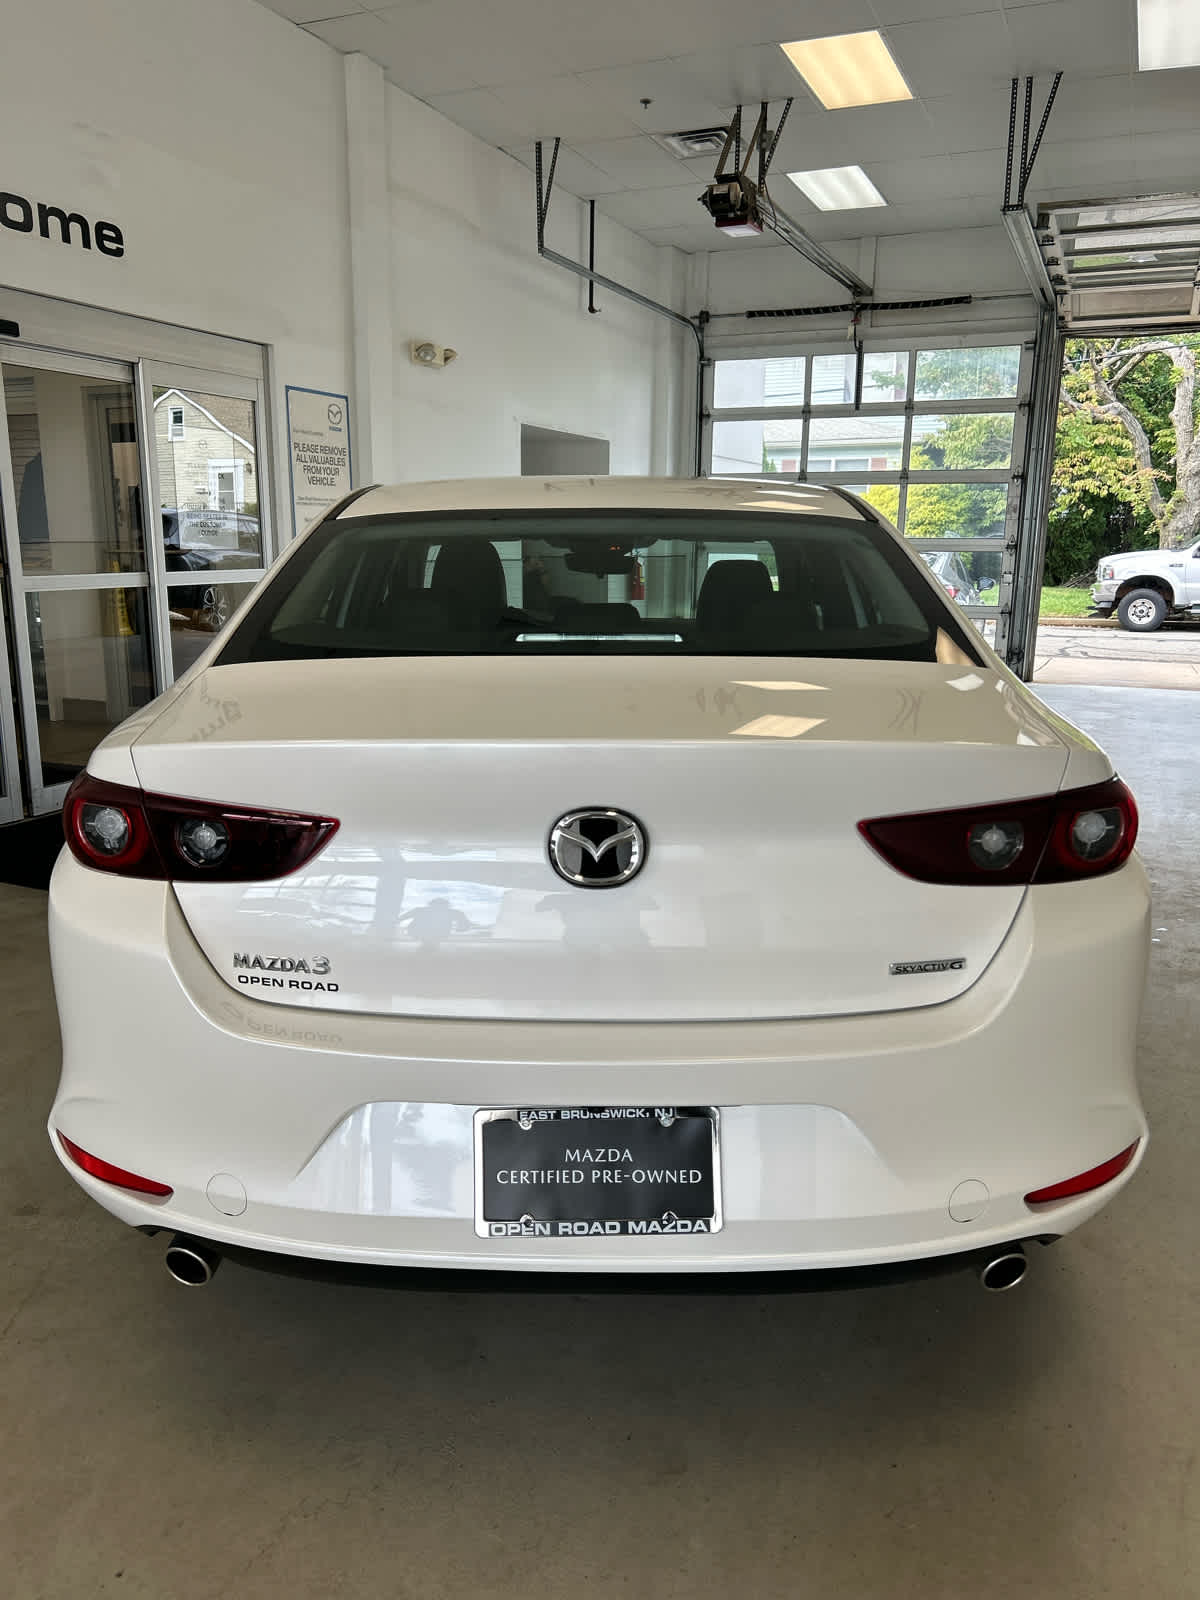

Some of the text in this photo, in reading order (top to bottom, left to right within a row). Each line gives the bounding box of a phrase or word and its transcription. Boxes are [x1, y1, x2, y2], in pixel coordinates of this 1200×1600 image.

[293, 442, 347, 457] PLEASE REMOVE
[296, 453, 346, 467] ALL VALUABLES
[303, 465, 340, 477] FROM YOUR
[238, 975, 339, 992] OPEN ROAD
[519, 1110, 556, 1120] EAST
[654, 1107, 674, 1119] NJ
[565, 1148, 633, 1163] MAZDA
[497, 1169, 702, 1184] CERTIFIED PRE-OWNED
[490, 1219, 708, 1237] OPEN ROAD MAZDA
